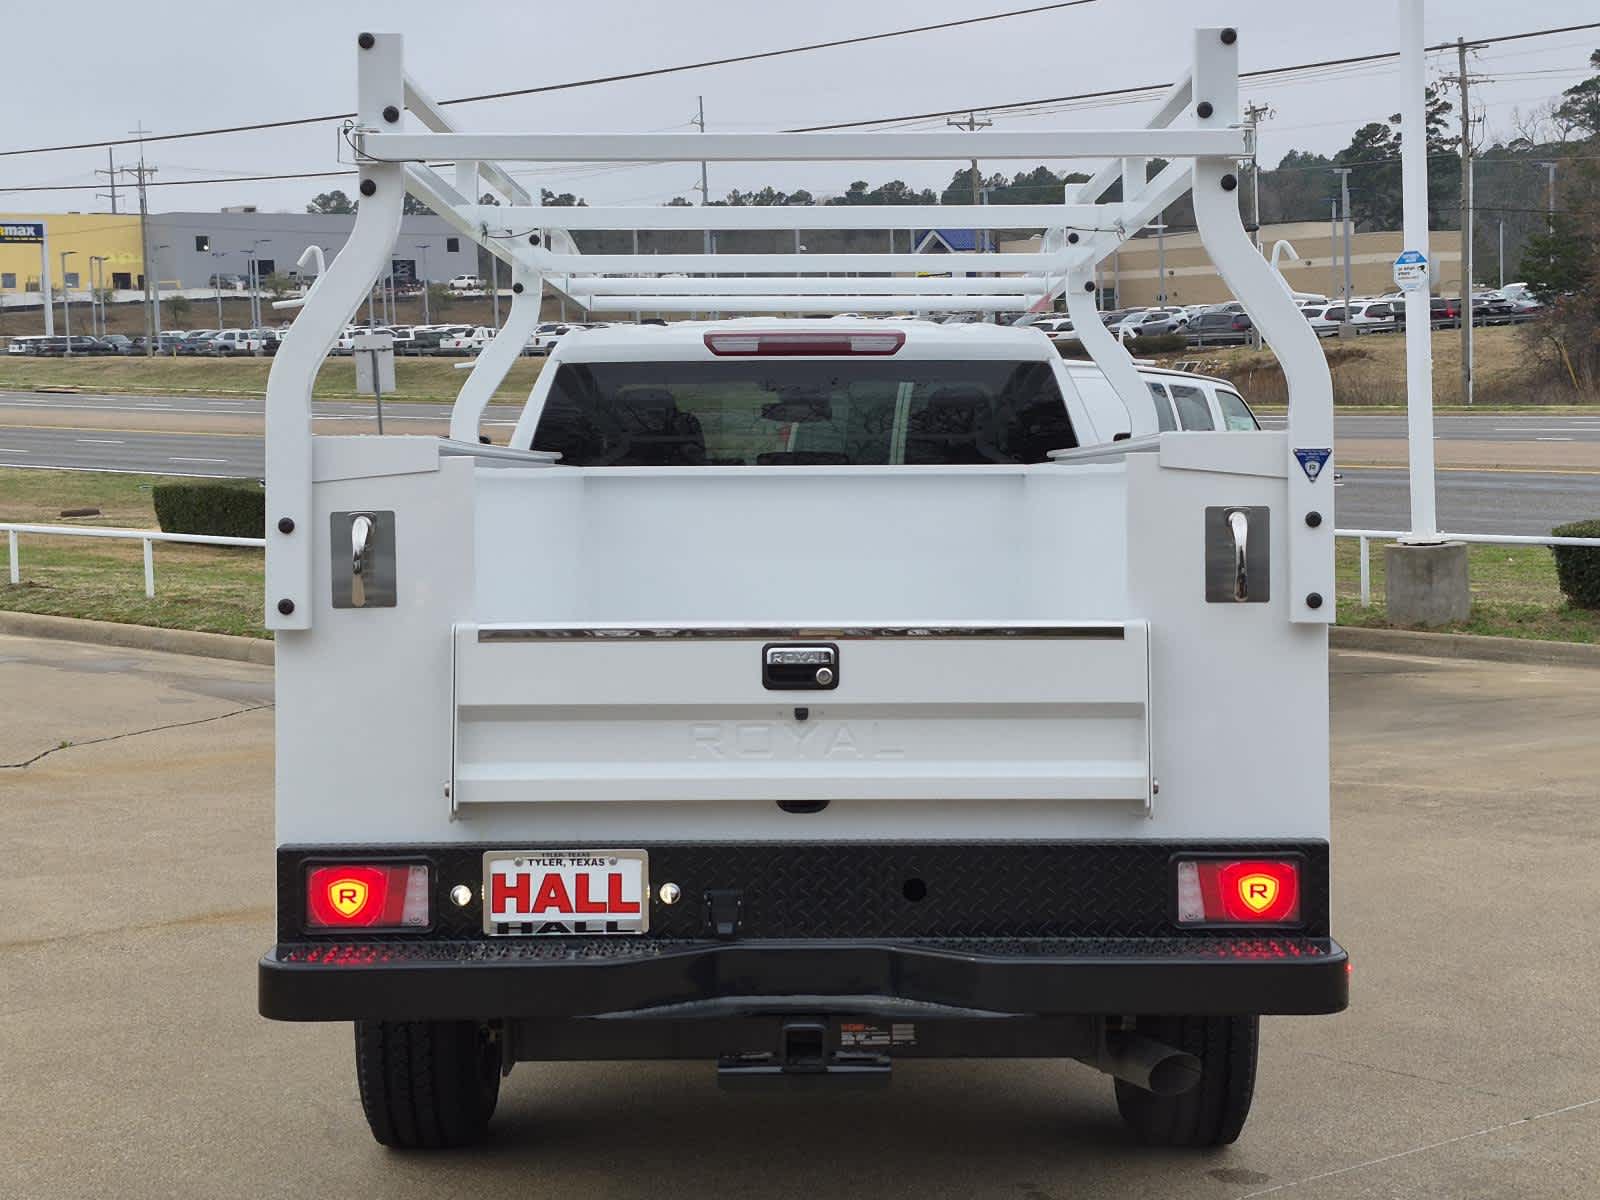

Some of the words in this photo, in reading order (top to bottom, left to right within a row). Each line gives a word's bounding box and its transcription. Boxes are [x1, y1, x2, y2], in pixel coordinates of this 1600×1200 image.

[772, 652, 830, 663] ROYAL
[687, 722, 905, 760] ROYAL
[527, 858, 566, 867] TYLER,
[570, 858, 605, 866] TEXAS
[339, 888, 357, 904] R
[491, 873, 641, 913] HALL
[1249, 883, 1268, 899] R
[497, 921, 636, 934] HALL
